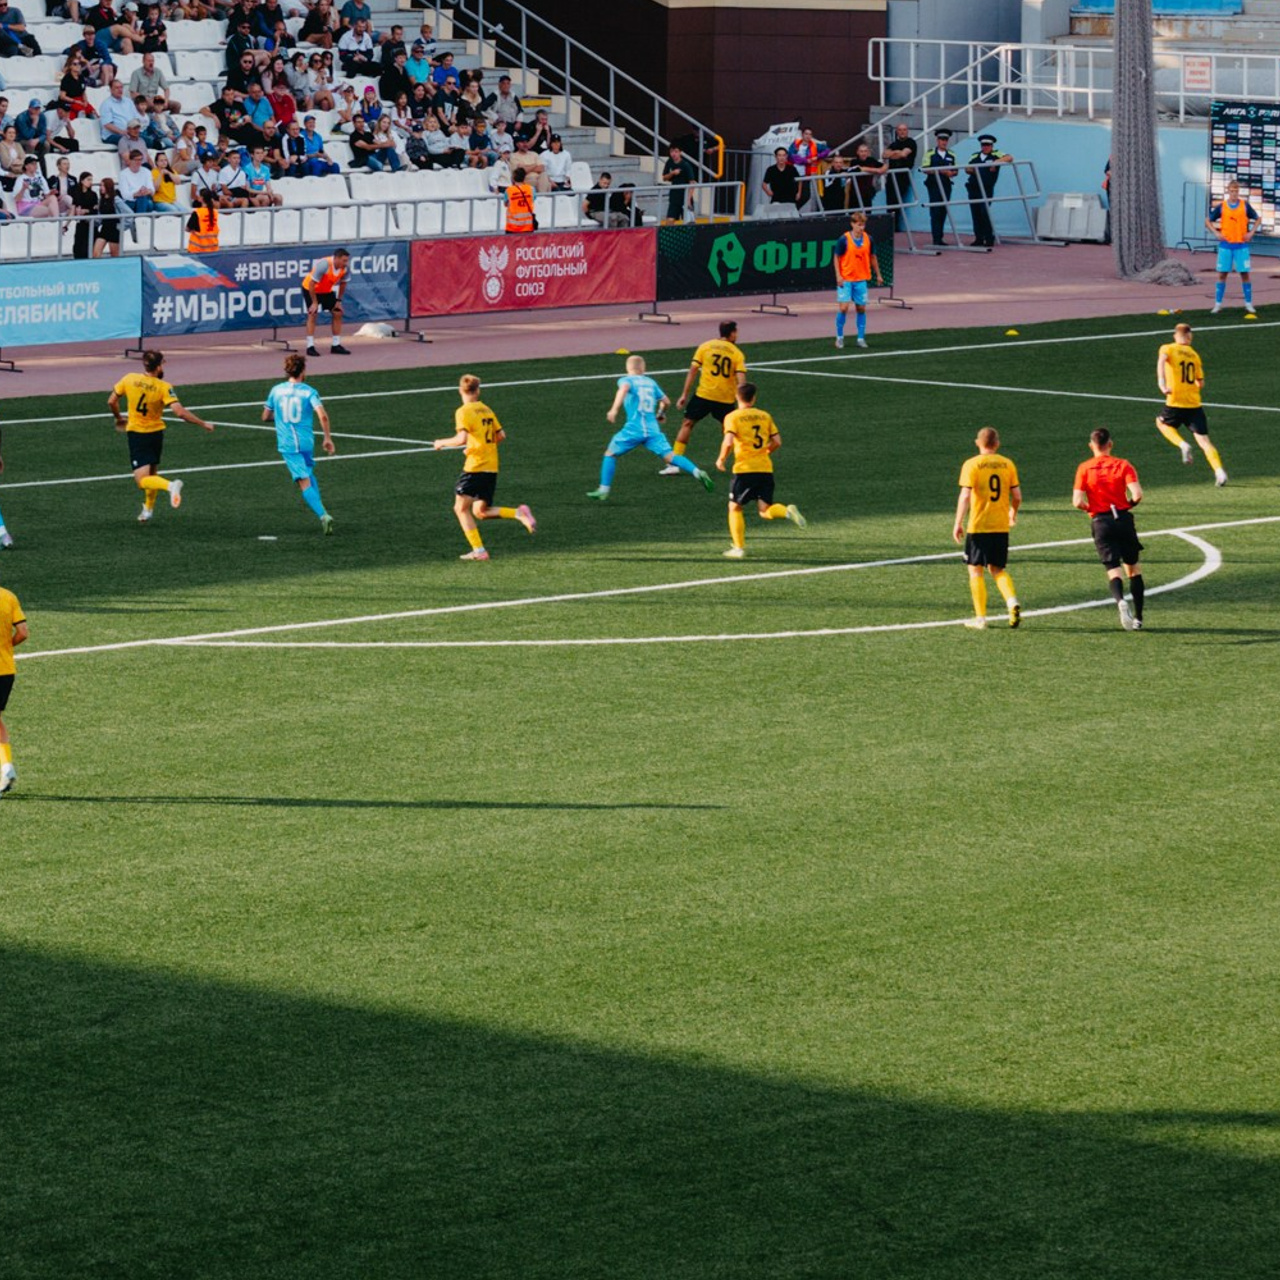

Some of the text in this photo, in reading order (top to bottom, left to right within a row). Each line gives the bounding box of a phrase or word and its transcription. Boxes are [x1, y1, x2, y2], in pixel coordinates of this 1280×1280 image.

[515, 242, 584, 261] РОССИЙСКИЙ
[234, 254, 399, 282] #ВПЕРЕССИЯ
[515, 260, 587, 279] ФУТБОЛЬНЫЙ
[67, 281, 100, 296] КЛУБ
[515, 282, 546, 297] СОЮЗ
[711, 354, 732, 378] 30
[1180, 361, 1196, 384] 10
[136, 393, 147, 417] 4
[279, 396, 302, 423] 10
[752, 425, 763, 449] 3
[989, 474, 1001, 502] 9
